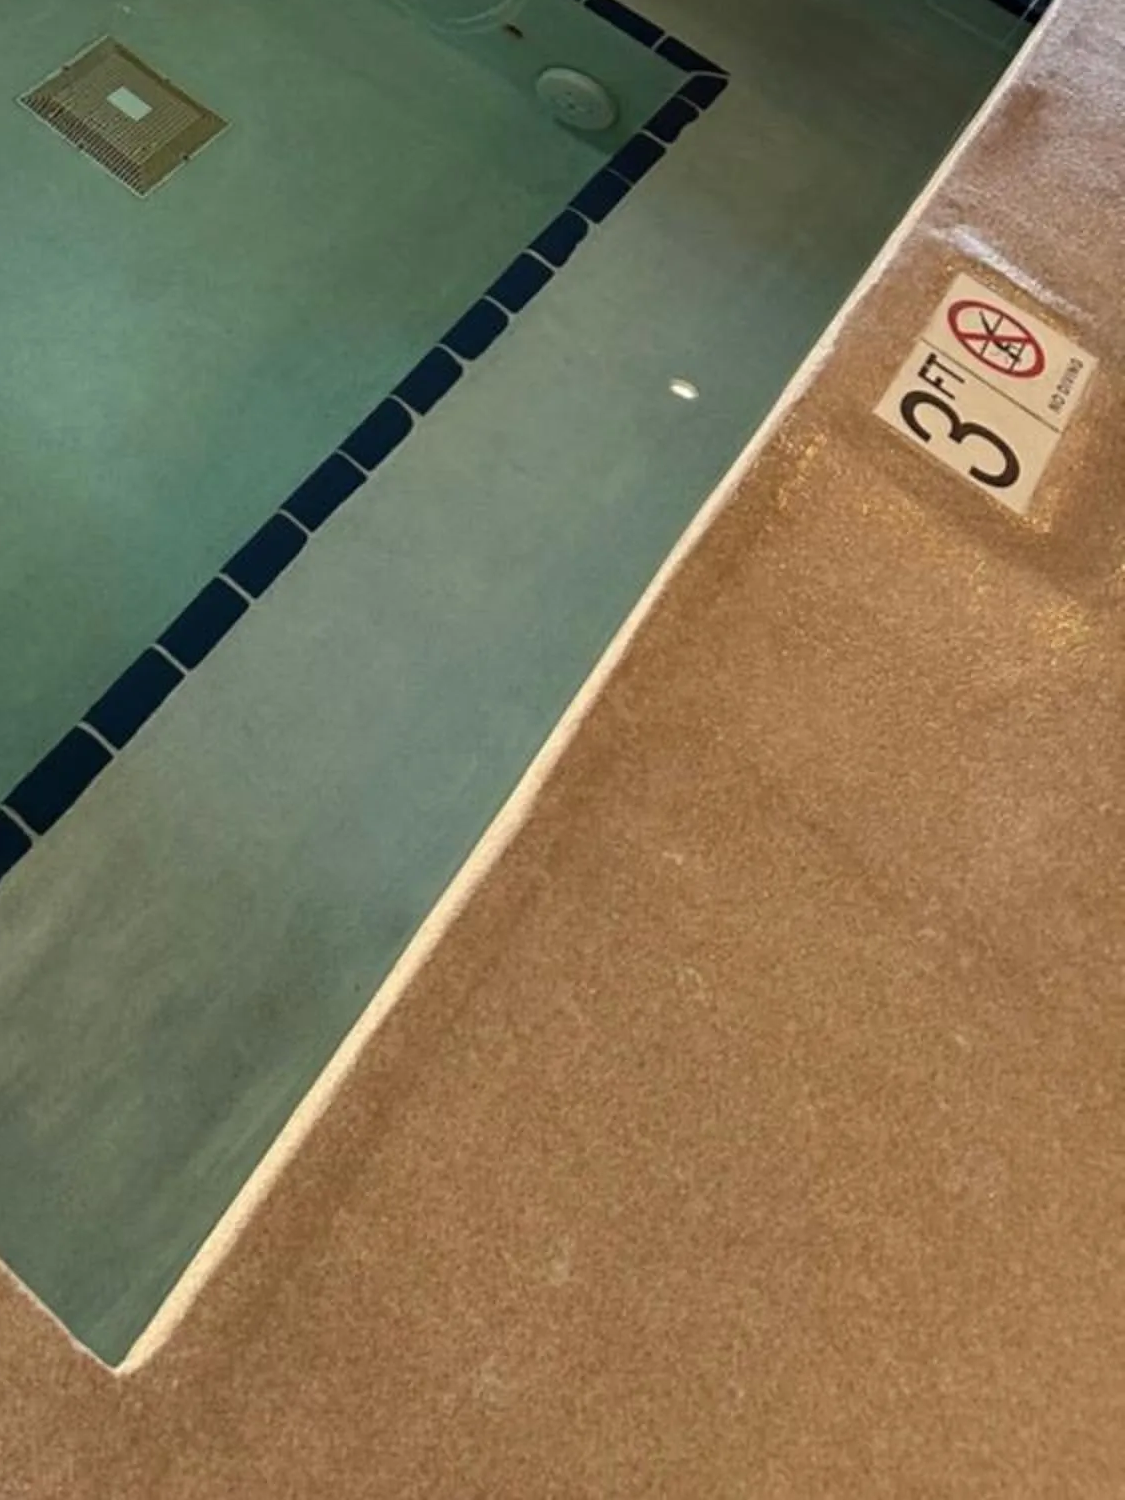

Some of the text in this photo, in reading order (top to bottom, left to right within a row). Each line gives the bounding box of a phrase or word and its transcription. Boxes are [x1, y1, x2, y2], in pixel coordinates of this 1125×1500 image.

[900, 352, 1020, 488] 3 FT
[1048, 358, 1084, 414] NO DIVING
